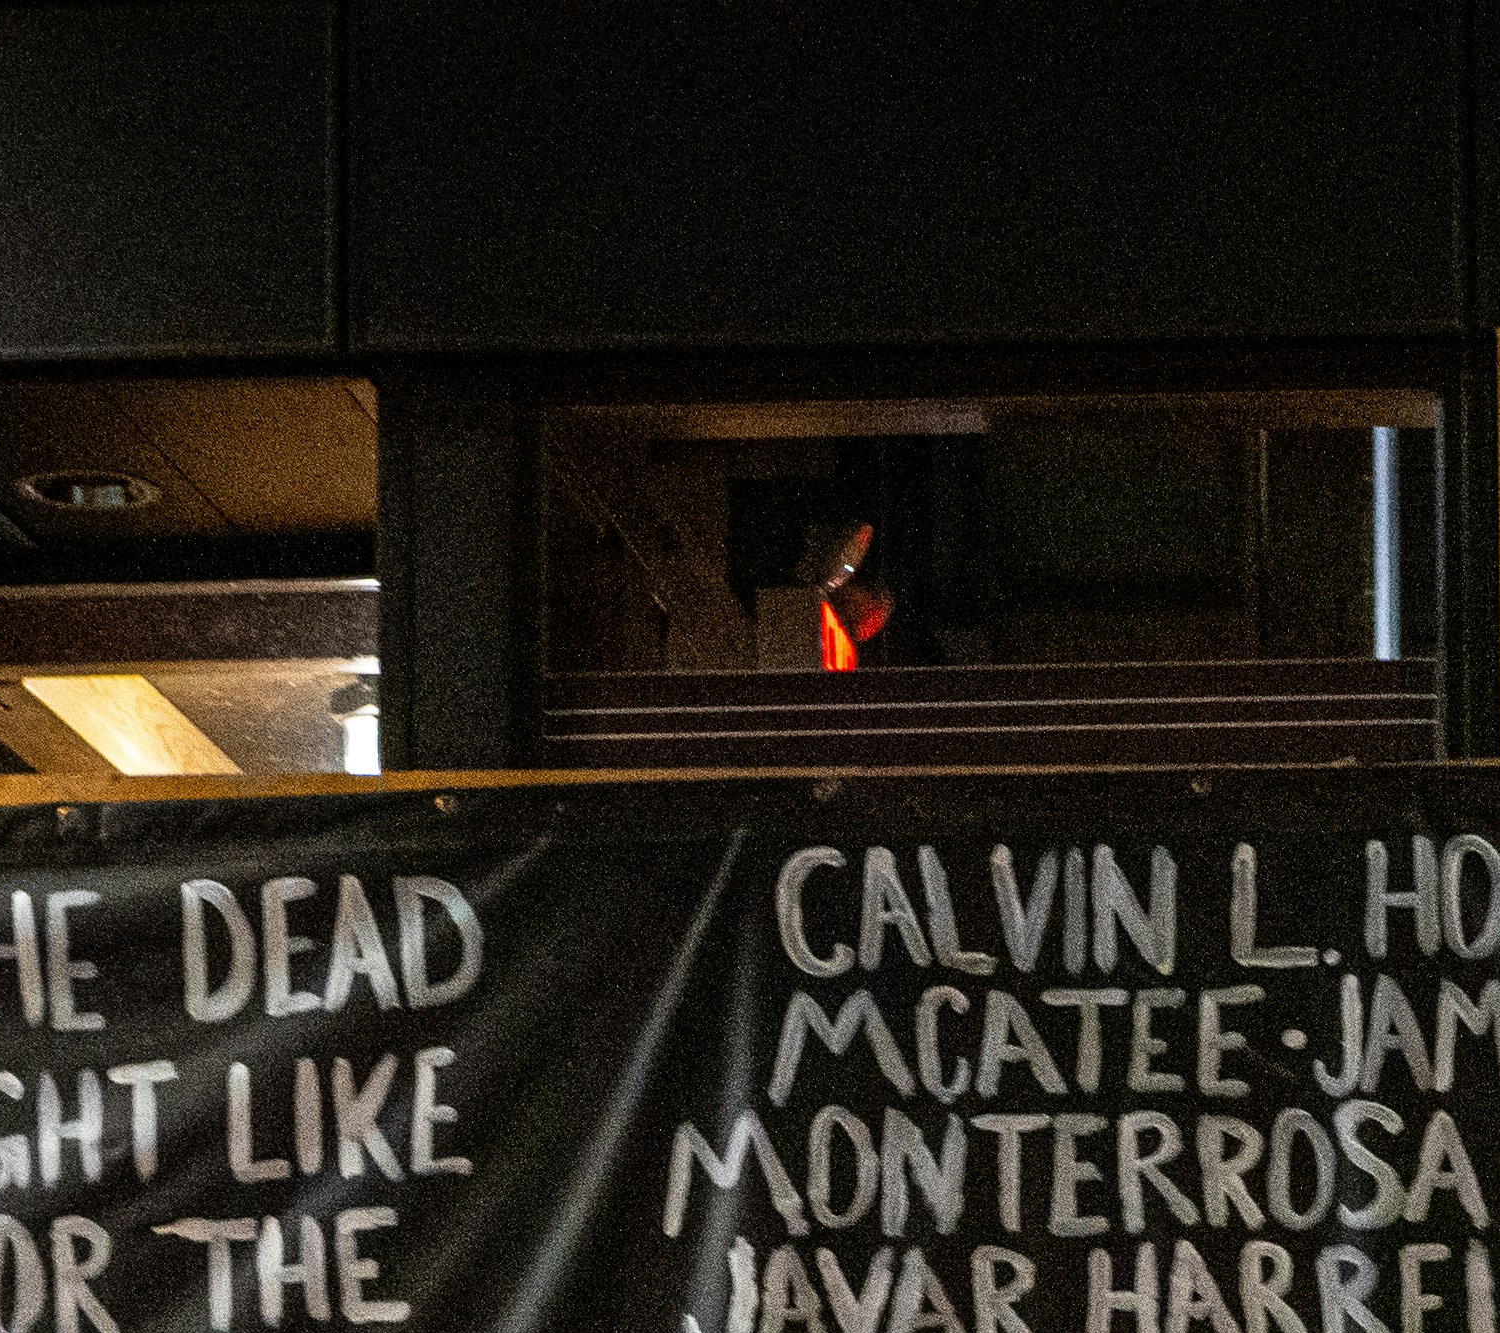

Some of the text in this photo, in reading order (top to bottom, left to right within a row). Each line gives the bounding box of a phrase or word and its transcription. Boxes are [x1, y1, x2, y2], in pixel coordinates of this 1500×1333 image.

[180, 873, 485, 1025] DEAD
[776, 843, 1177, 978] CALVIN
[1231, 842, 1341, 968] L.
[767, 984, 1266, 1107] MCATEE
[226, 1047, 472, 1185] LIKE
[664, 1100, 1489, 1238] MONTERROSA
[151, 1205, 411, 1333] THE
